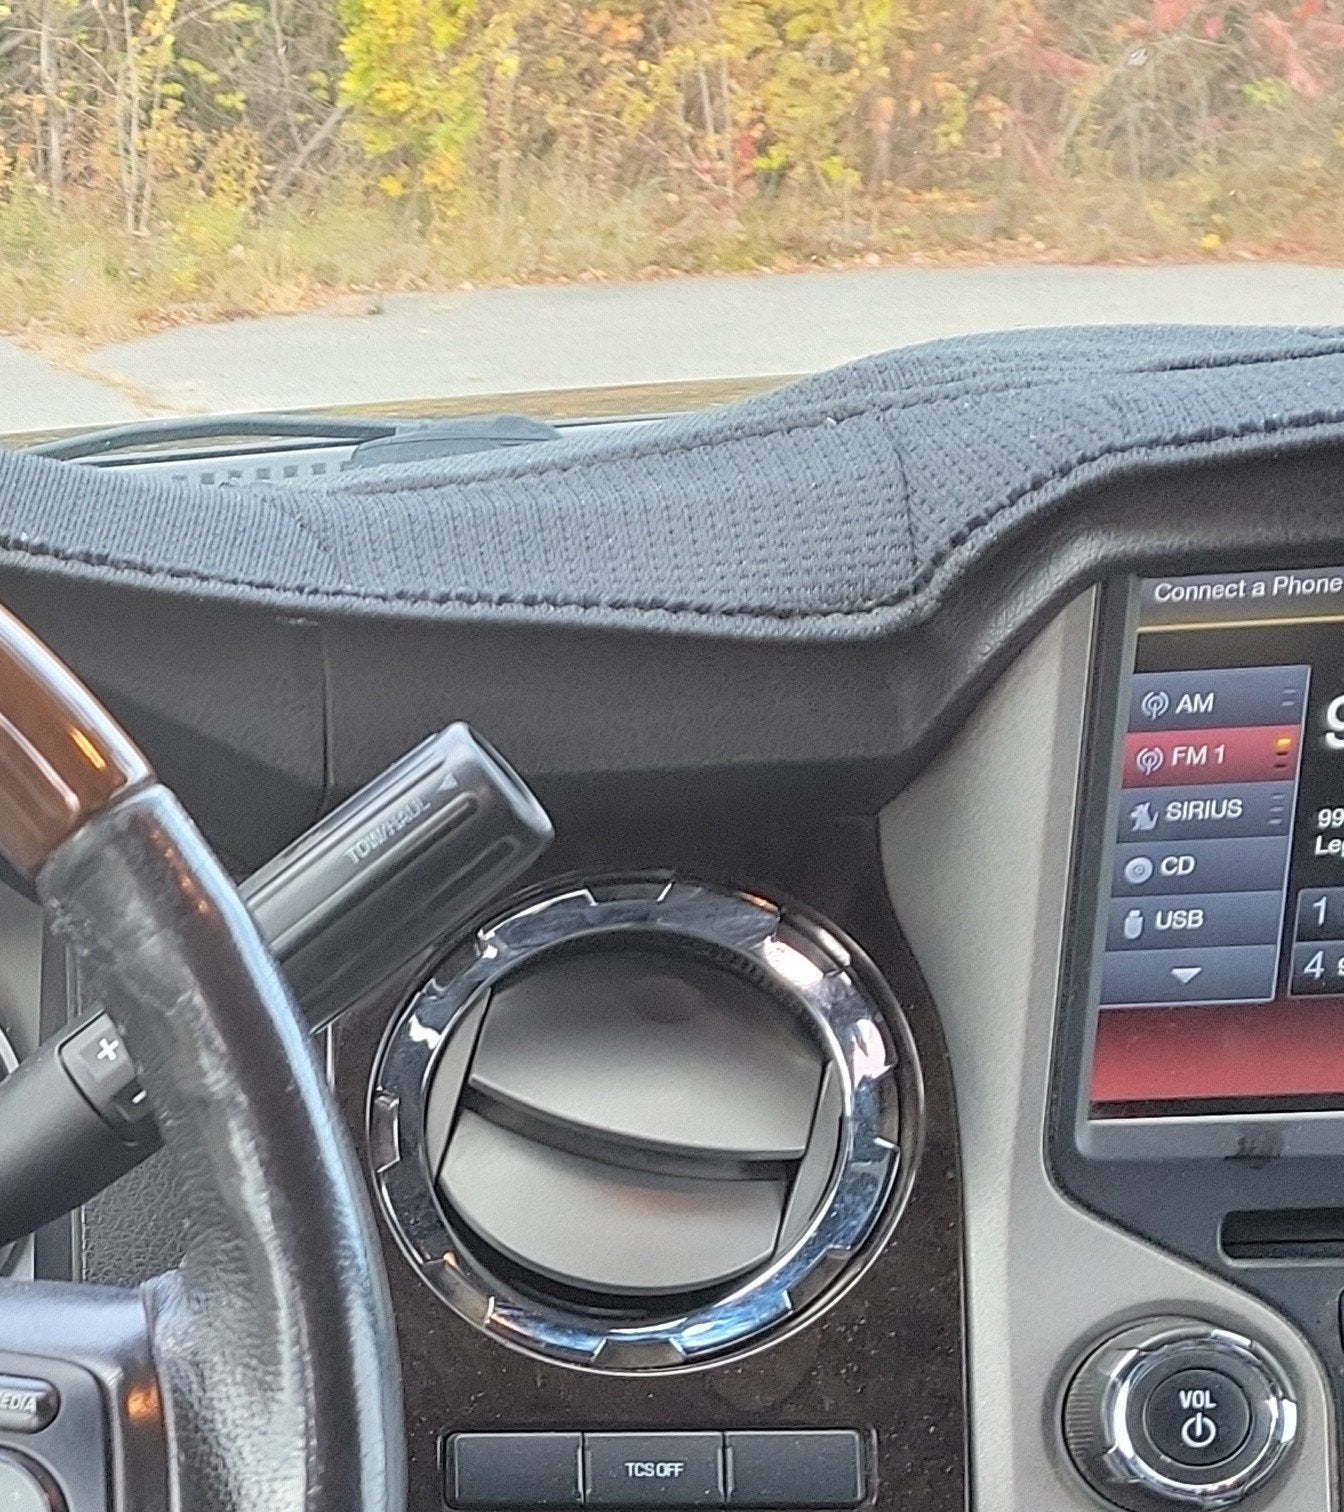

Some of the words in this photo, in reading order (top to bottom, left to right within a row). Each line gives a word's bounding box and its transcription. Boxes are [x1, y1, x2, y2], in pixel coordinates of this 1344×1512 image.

[1153, 580, 1248, 603] Connect
[1251, 581, 1266, 598] a
[1271, 575, 1344, 597] Phone
[1175, 693, 1215, 714] AM
[1171, 746, 1208, 767] FM
[1213, 745, 1226, 765] 1
[1165, 799, 1244, 821] SIRIUS
[1160, 856, 1196, 877] CD
[1154, 910, 1205, 931] USB
[1313, 895, 1328, 926] 1
[1303, 950, 1325, 979] 4
[1179, 1389, 1216, 1409] VOL
[624, 1462, 654, 1478] TCS
[655, 1462, 684, 1478] OFF
